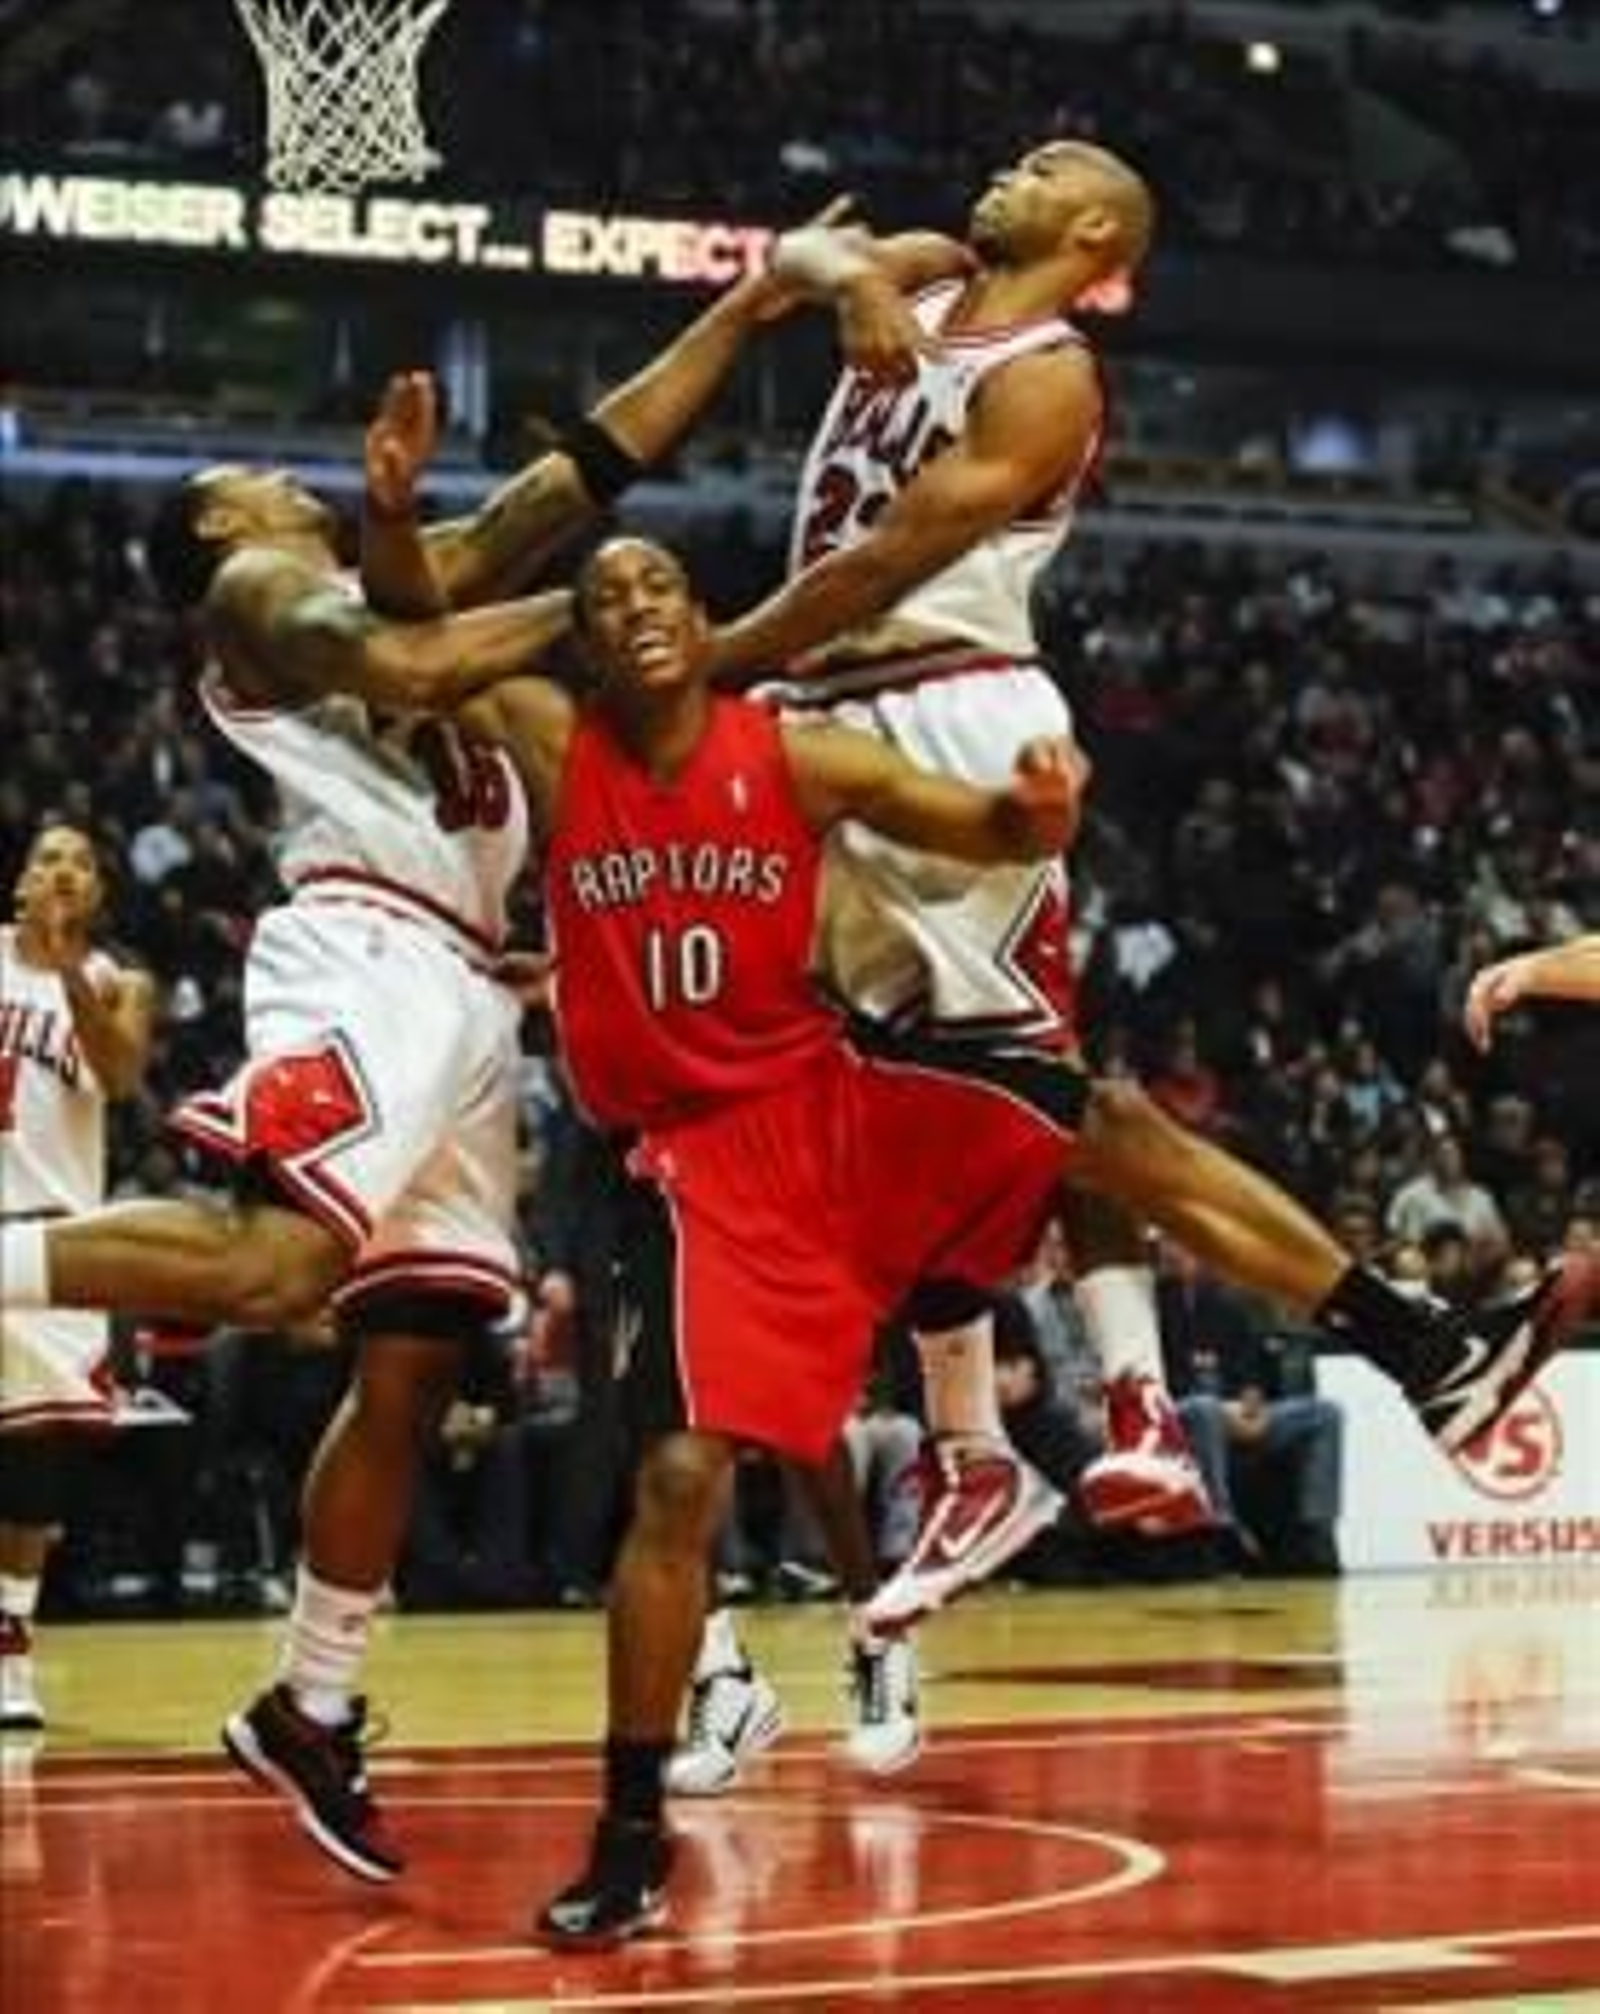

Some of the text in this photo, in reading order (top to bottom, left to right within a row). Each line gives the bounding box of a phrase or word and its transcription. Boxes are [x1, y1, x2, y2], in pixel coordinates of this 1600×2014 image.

[543, 209, 774, 283] EXPECT
[571, 841, 788, 912] RAPTORS
[648, 922, 722, 1013] 10
[1427, 1515, 1600, 1558] VERSUS
